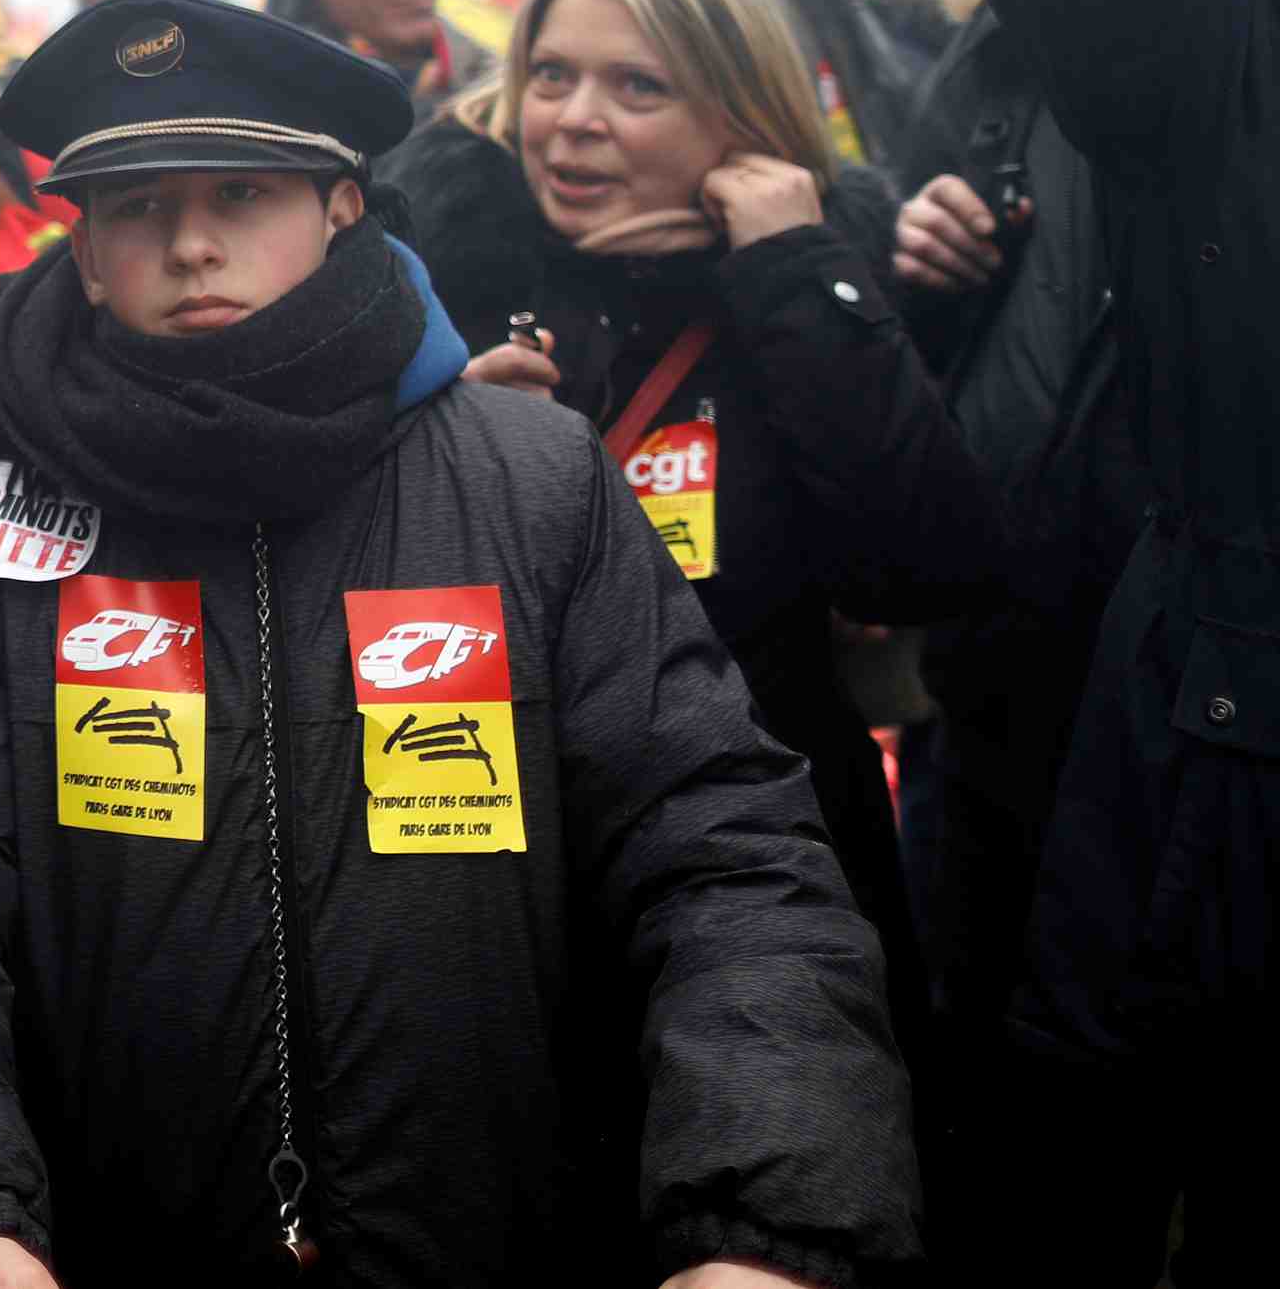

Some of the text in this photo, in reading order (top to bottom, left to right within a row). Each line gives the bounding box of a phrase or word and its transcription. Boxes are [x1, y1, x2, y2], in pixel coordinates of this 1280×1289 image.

[624, 440, 707, 494] cgt
[63, 772, 196, 797] SYNDICAT CGT DES CHEMINOTS
[85, 801, 173, 822] PARIS GARE DE LYON
[373, 794, 512, 809] SYNDICAT CGT DES CHEMINOTS
[399, 822, 492, 837] PARIS GARE DE LYON
